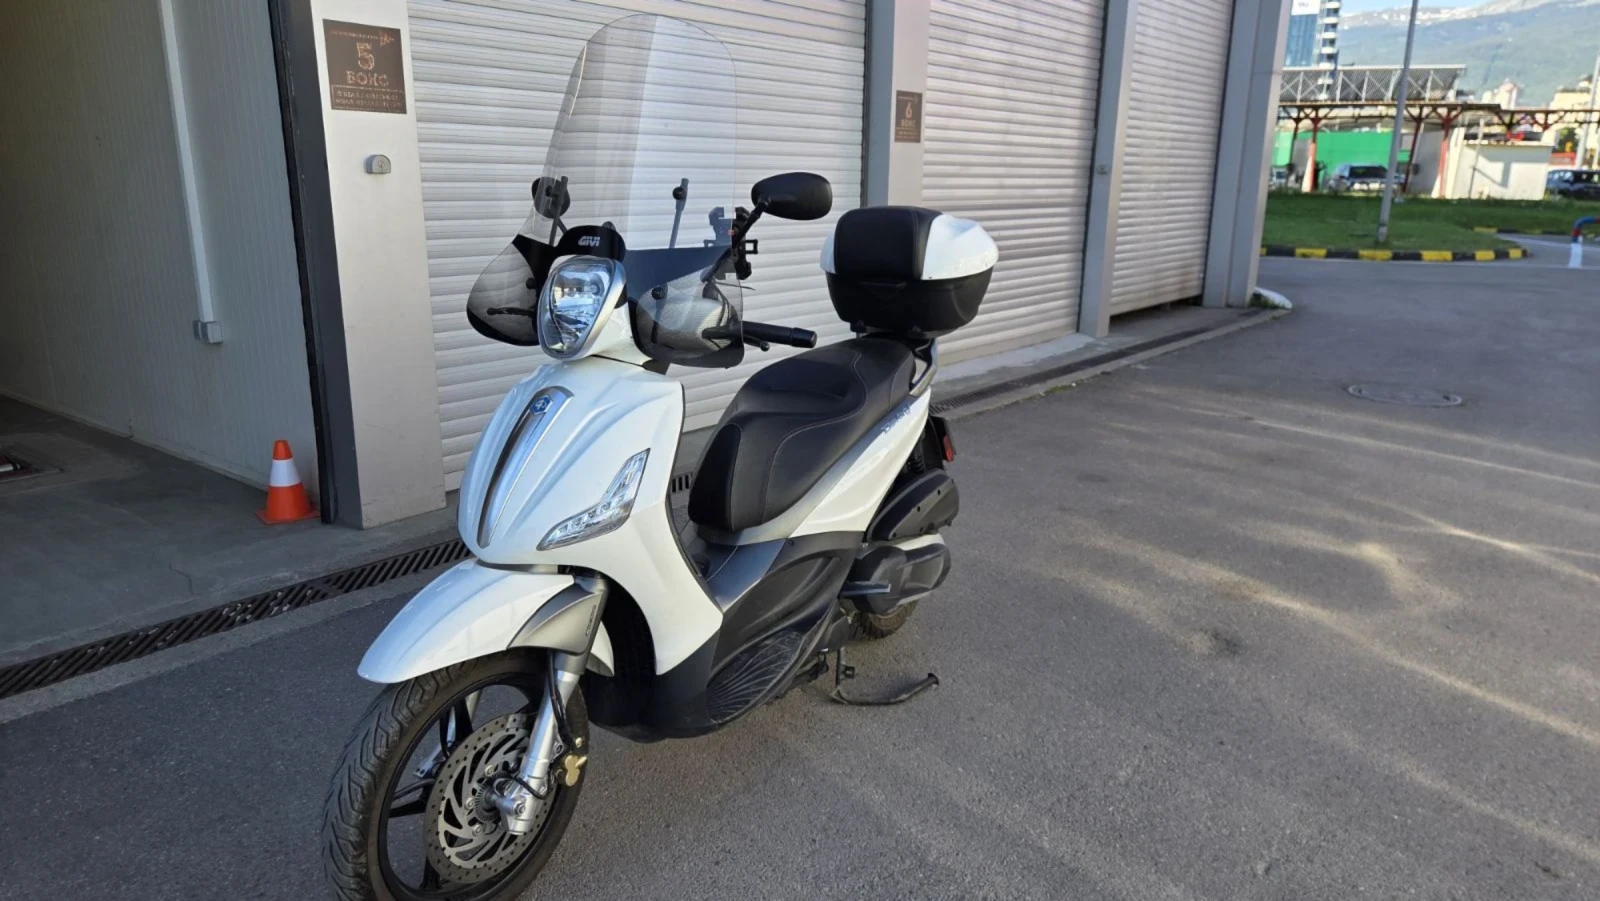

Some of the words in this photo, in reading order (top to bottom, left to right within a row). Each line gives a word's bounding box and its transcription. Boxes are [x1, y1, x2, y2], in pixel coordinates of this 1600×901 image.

[356, 41, 375, 71] 5
[905, 101, 913, 118] 6
[578, 236, 601, 246] GIVI
